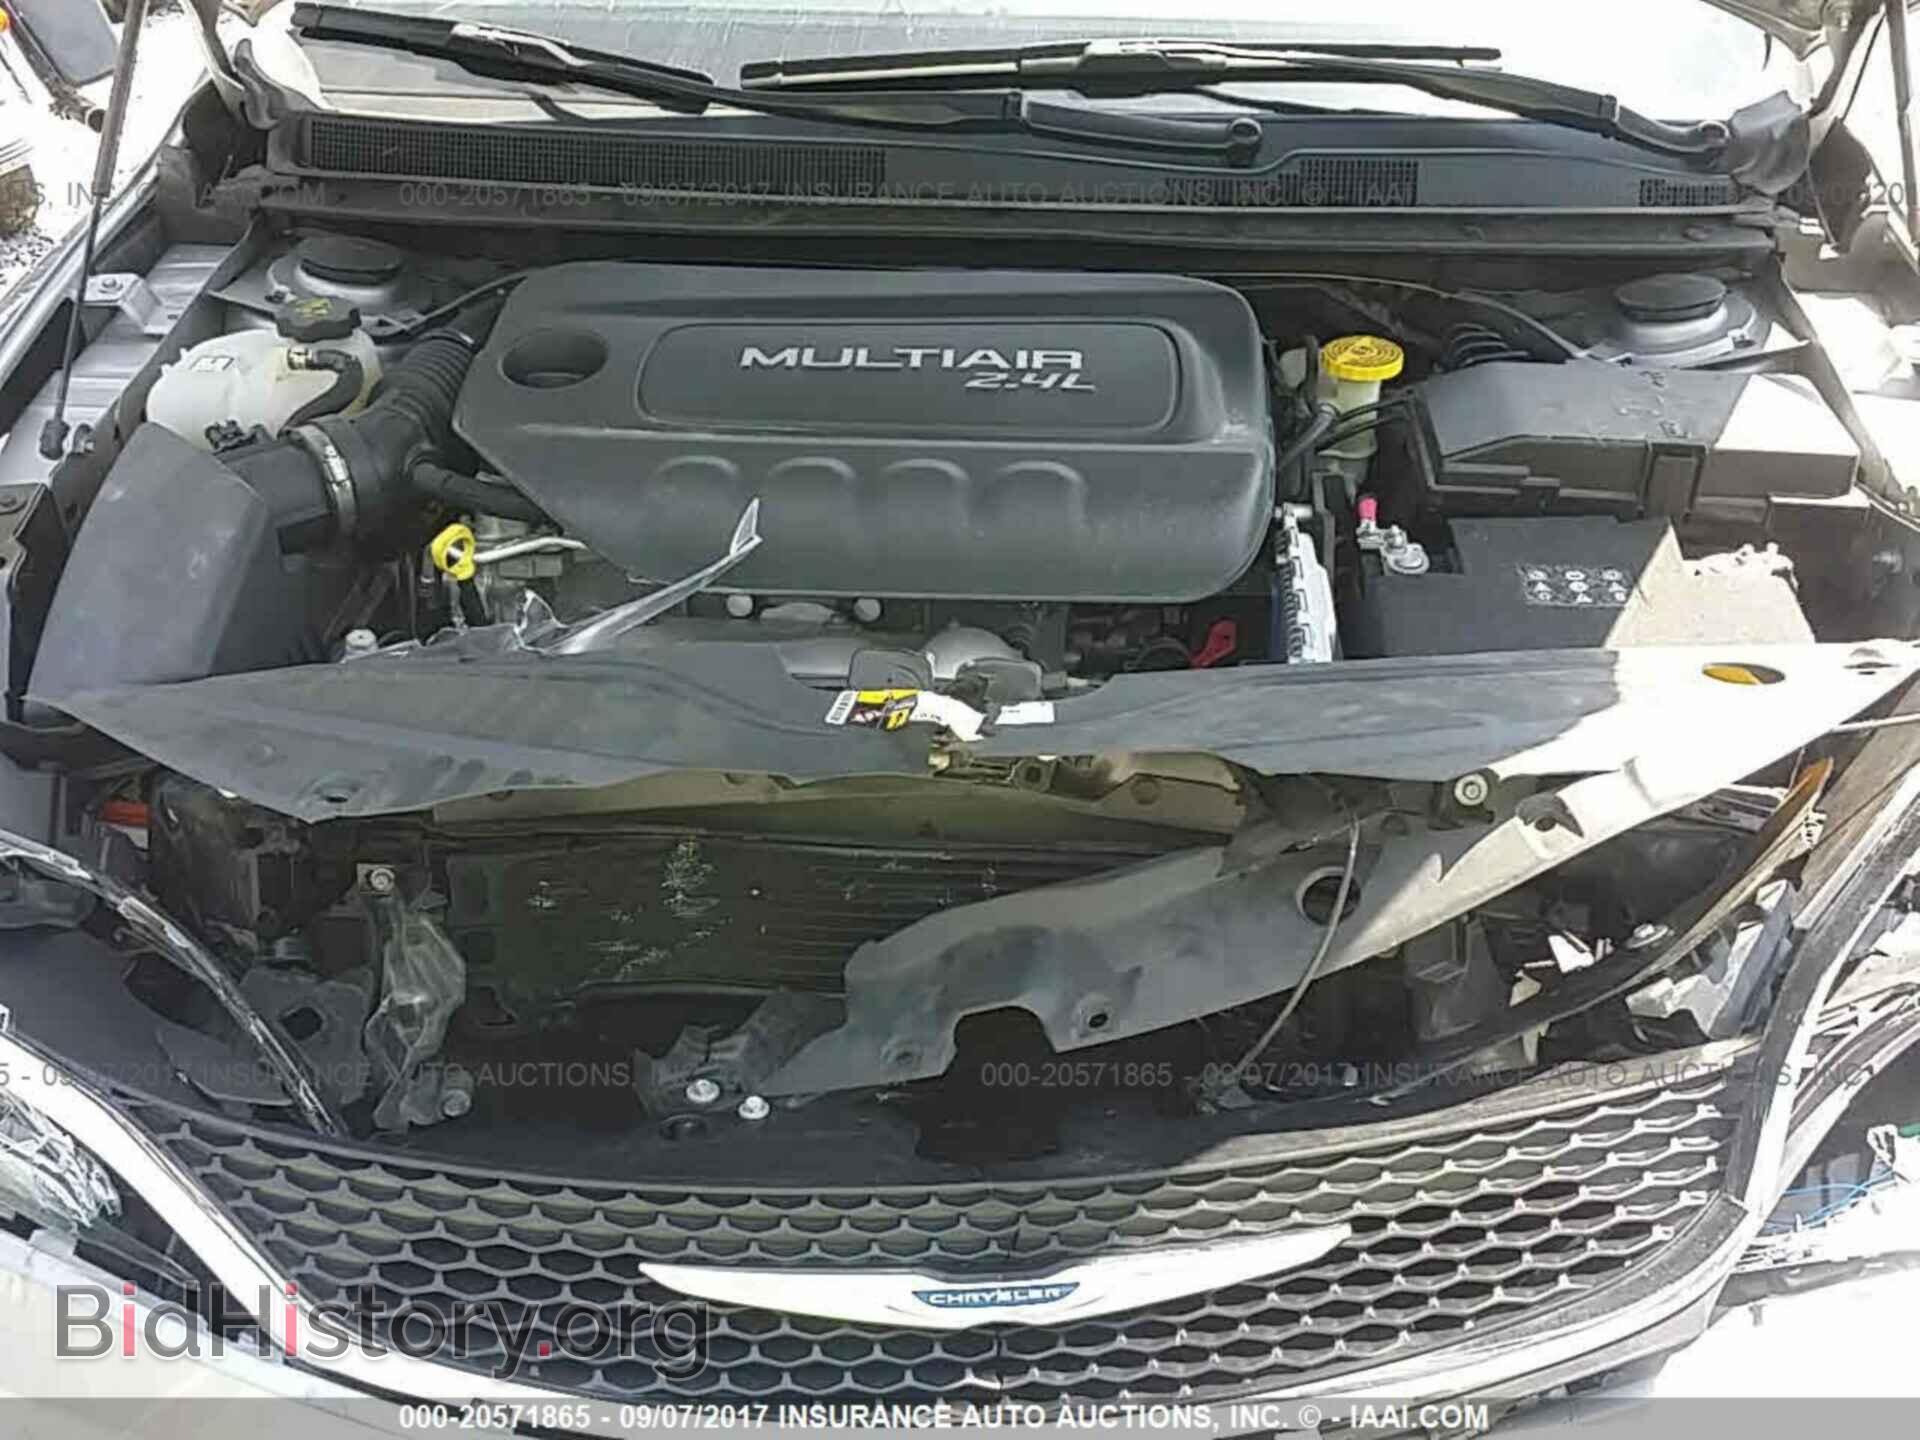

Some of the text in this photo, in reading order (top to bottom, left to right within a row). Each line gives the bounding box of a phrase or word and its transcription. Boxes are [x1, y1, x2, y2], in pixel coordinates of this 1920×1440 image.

[739, 346, 1084, 369] MULTIAIR
[964, 372, 1096, 391] 2.4L
[928, 1287, 1062, 1306] CHRYSLER
